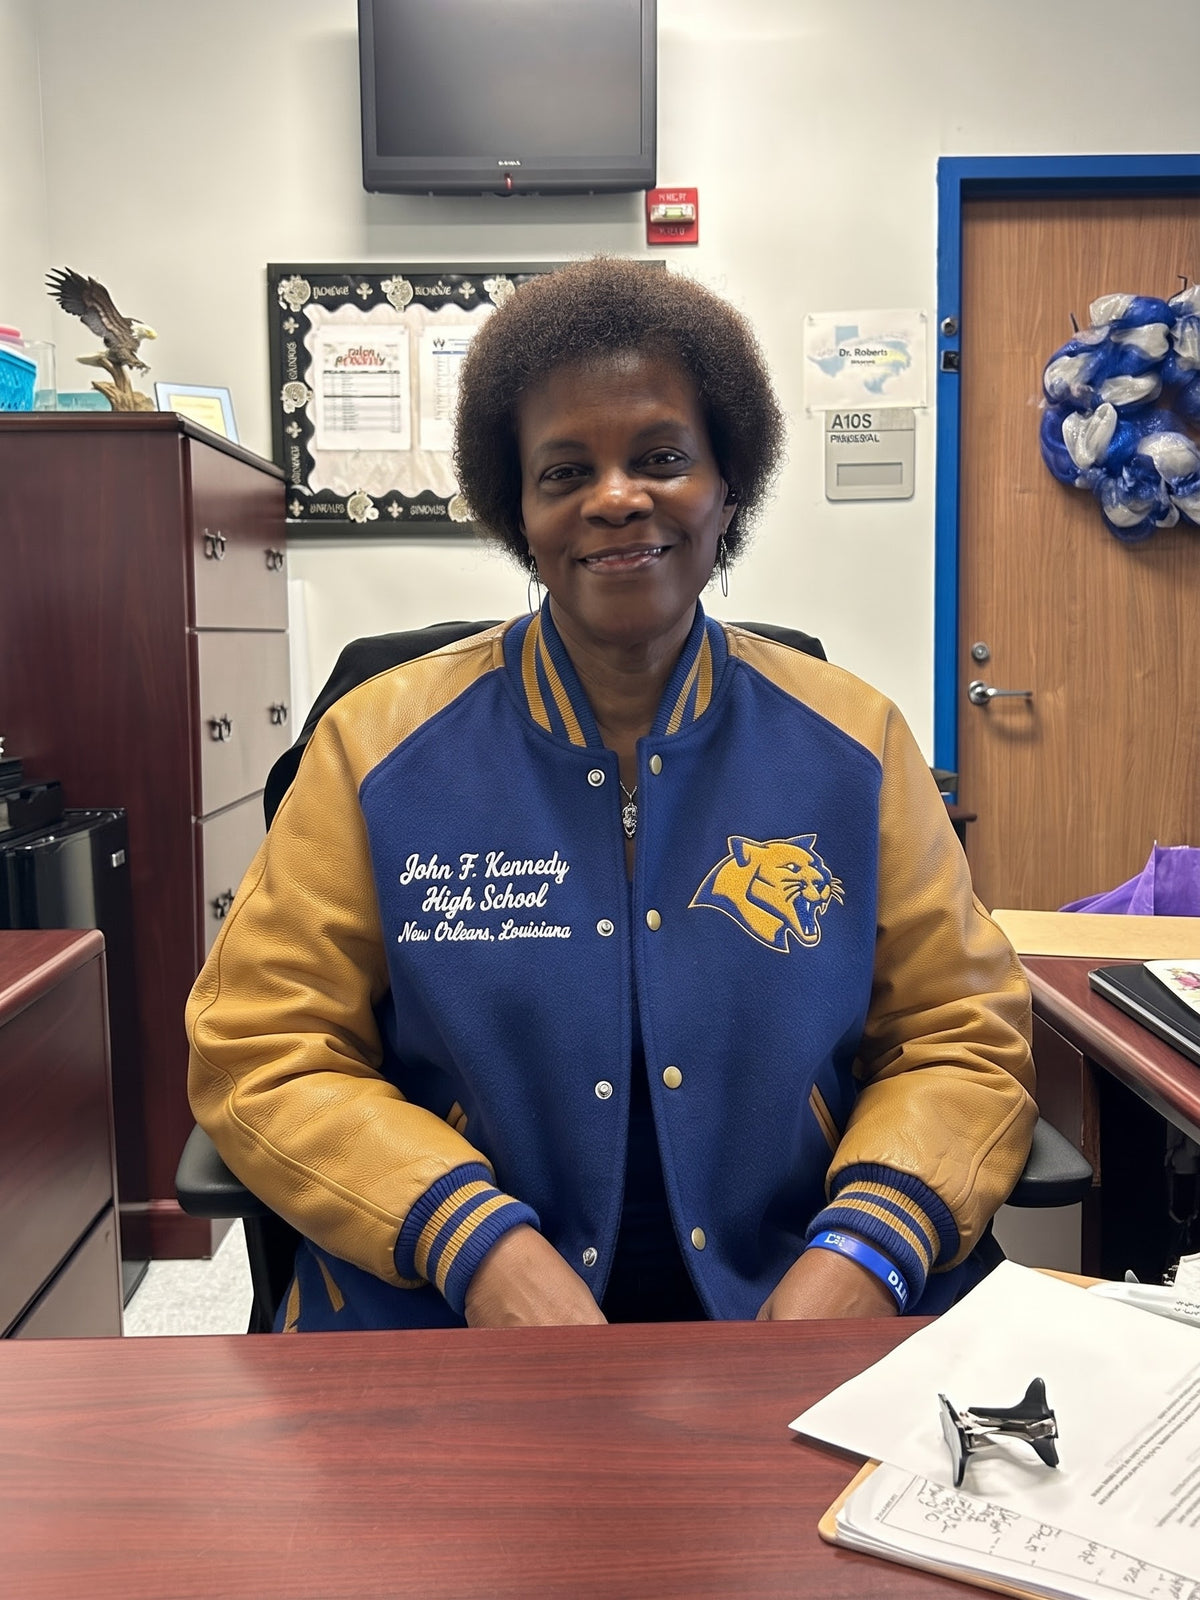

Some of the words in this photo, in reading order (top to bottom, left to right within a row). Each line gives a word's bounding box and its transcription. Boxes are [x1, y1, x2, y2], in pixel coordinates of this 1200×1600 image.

[839, 348, 852, 357] Dr.
[854, 348, 888, 357] Roberts
[400, 853, 454, 885] John
[458, 853, 479, 881] F.
[484, 850, 570, 884] Kennedy
[421, 885, 476, 919] High
[479, 882, 549, 911] School
[397, 920, 431, 943] New
[434, 920, 495, 942] Orleans,
[498, 918, 572, 941] Louisiana
